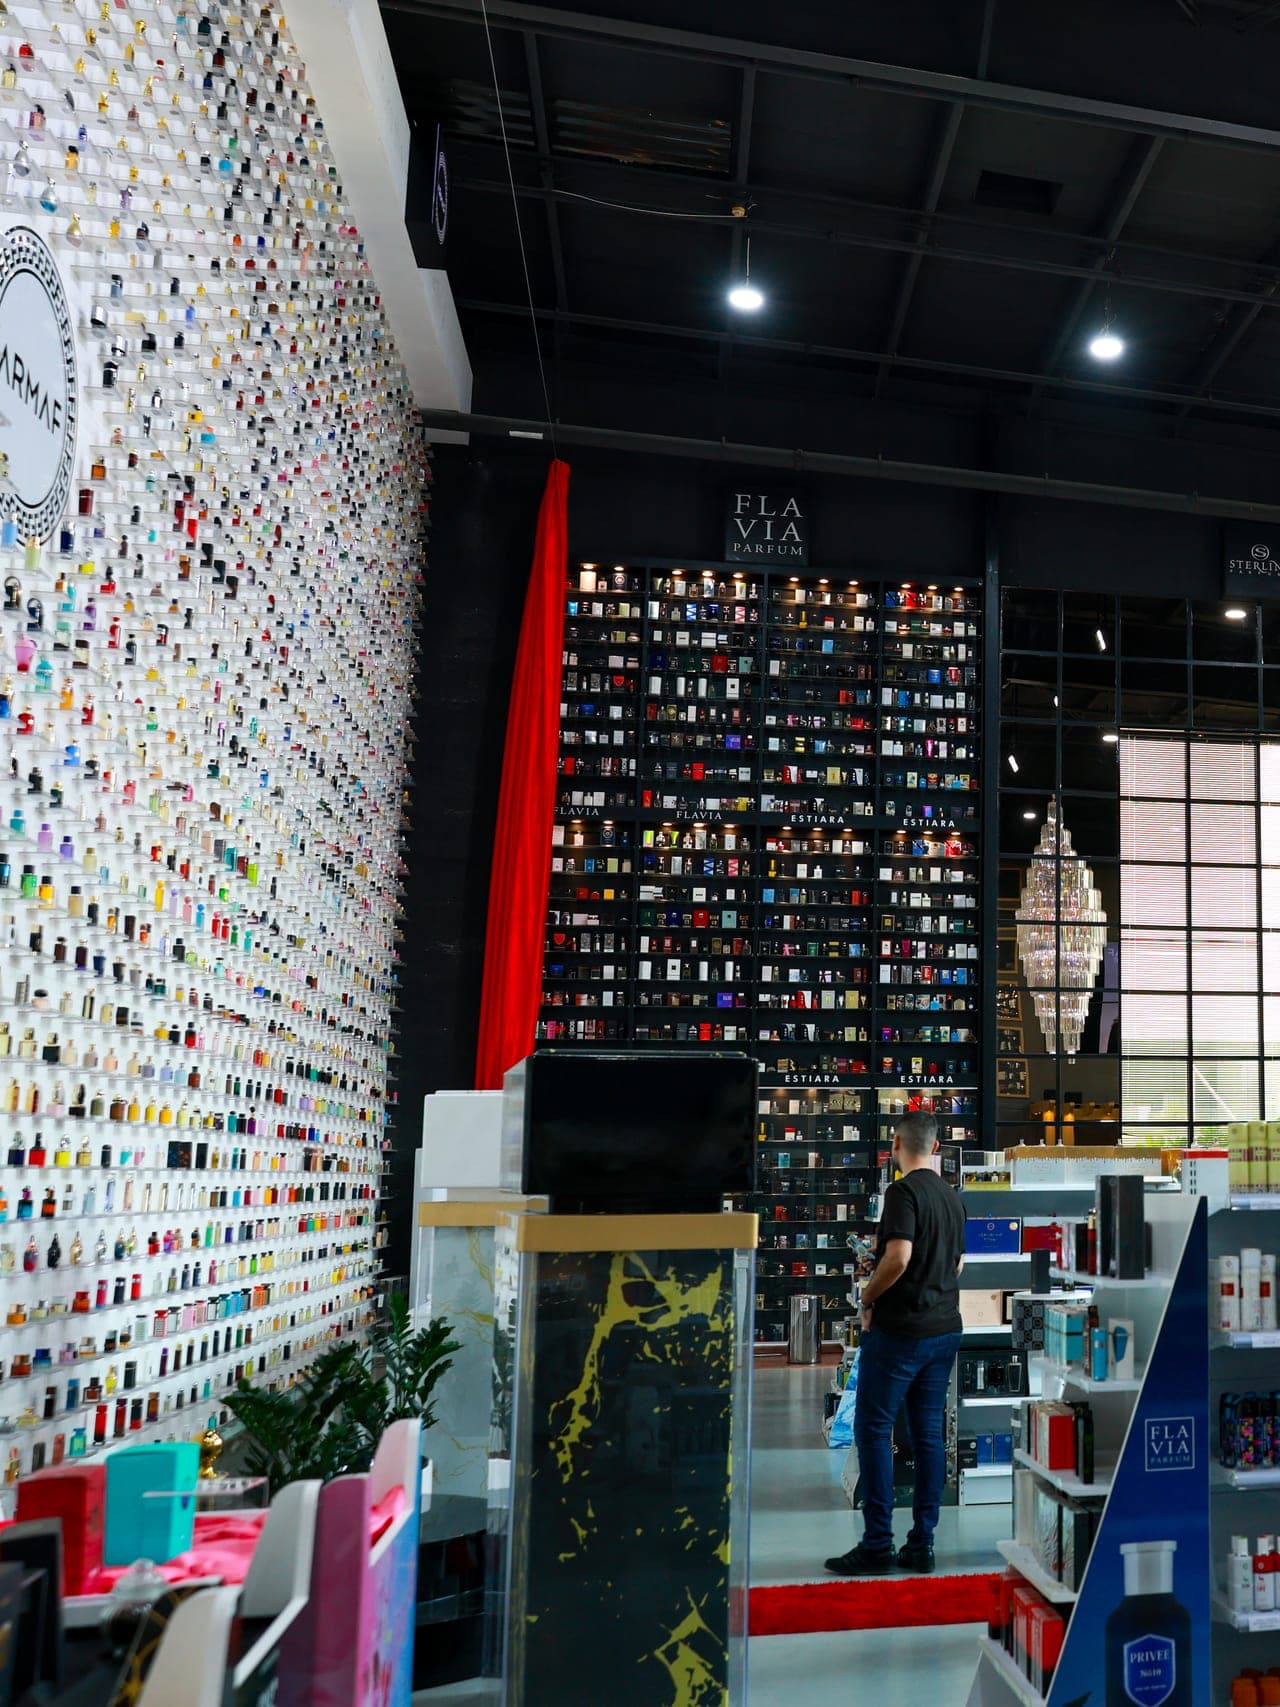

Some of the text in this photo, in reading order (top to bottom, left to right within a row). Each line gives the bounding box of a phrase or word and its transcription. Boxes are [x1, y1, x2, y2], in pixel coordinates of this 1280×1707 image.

[0, 343, 62, 434] ARMAF
[734, 493, 803, 518] FLA
[734, 518, 803, 542] VIA
[733, 542, 803, 556] PARFUM
[676, 811, 722, 820] FLAVIA
[791, 814, 845, 824] ESTIARA
[903, 818, 955, 828] ESTIARA
[785, 1074, 840, 1083] ESTIARA
[900, 1075, 954, 1084] ESTIARA
[1151, 1424, 1189, 1440] FLA
[1151, 1440, 1189, 1456] VIA
[1130, 1648, 1169, 1664] PRIVEE
